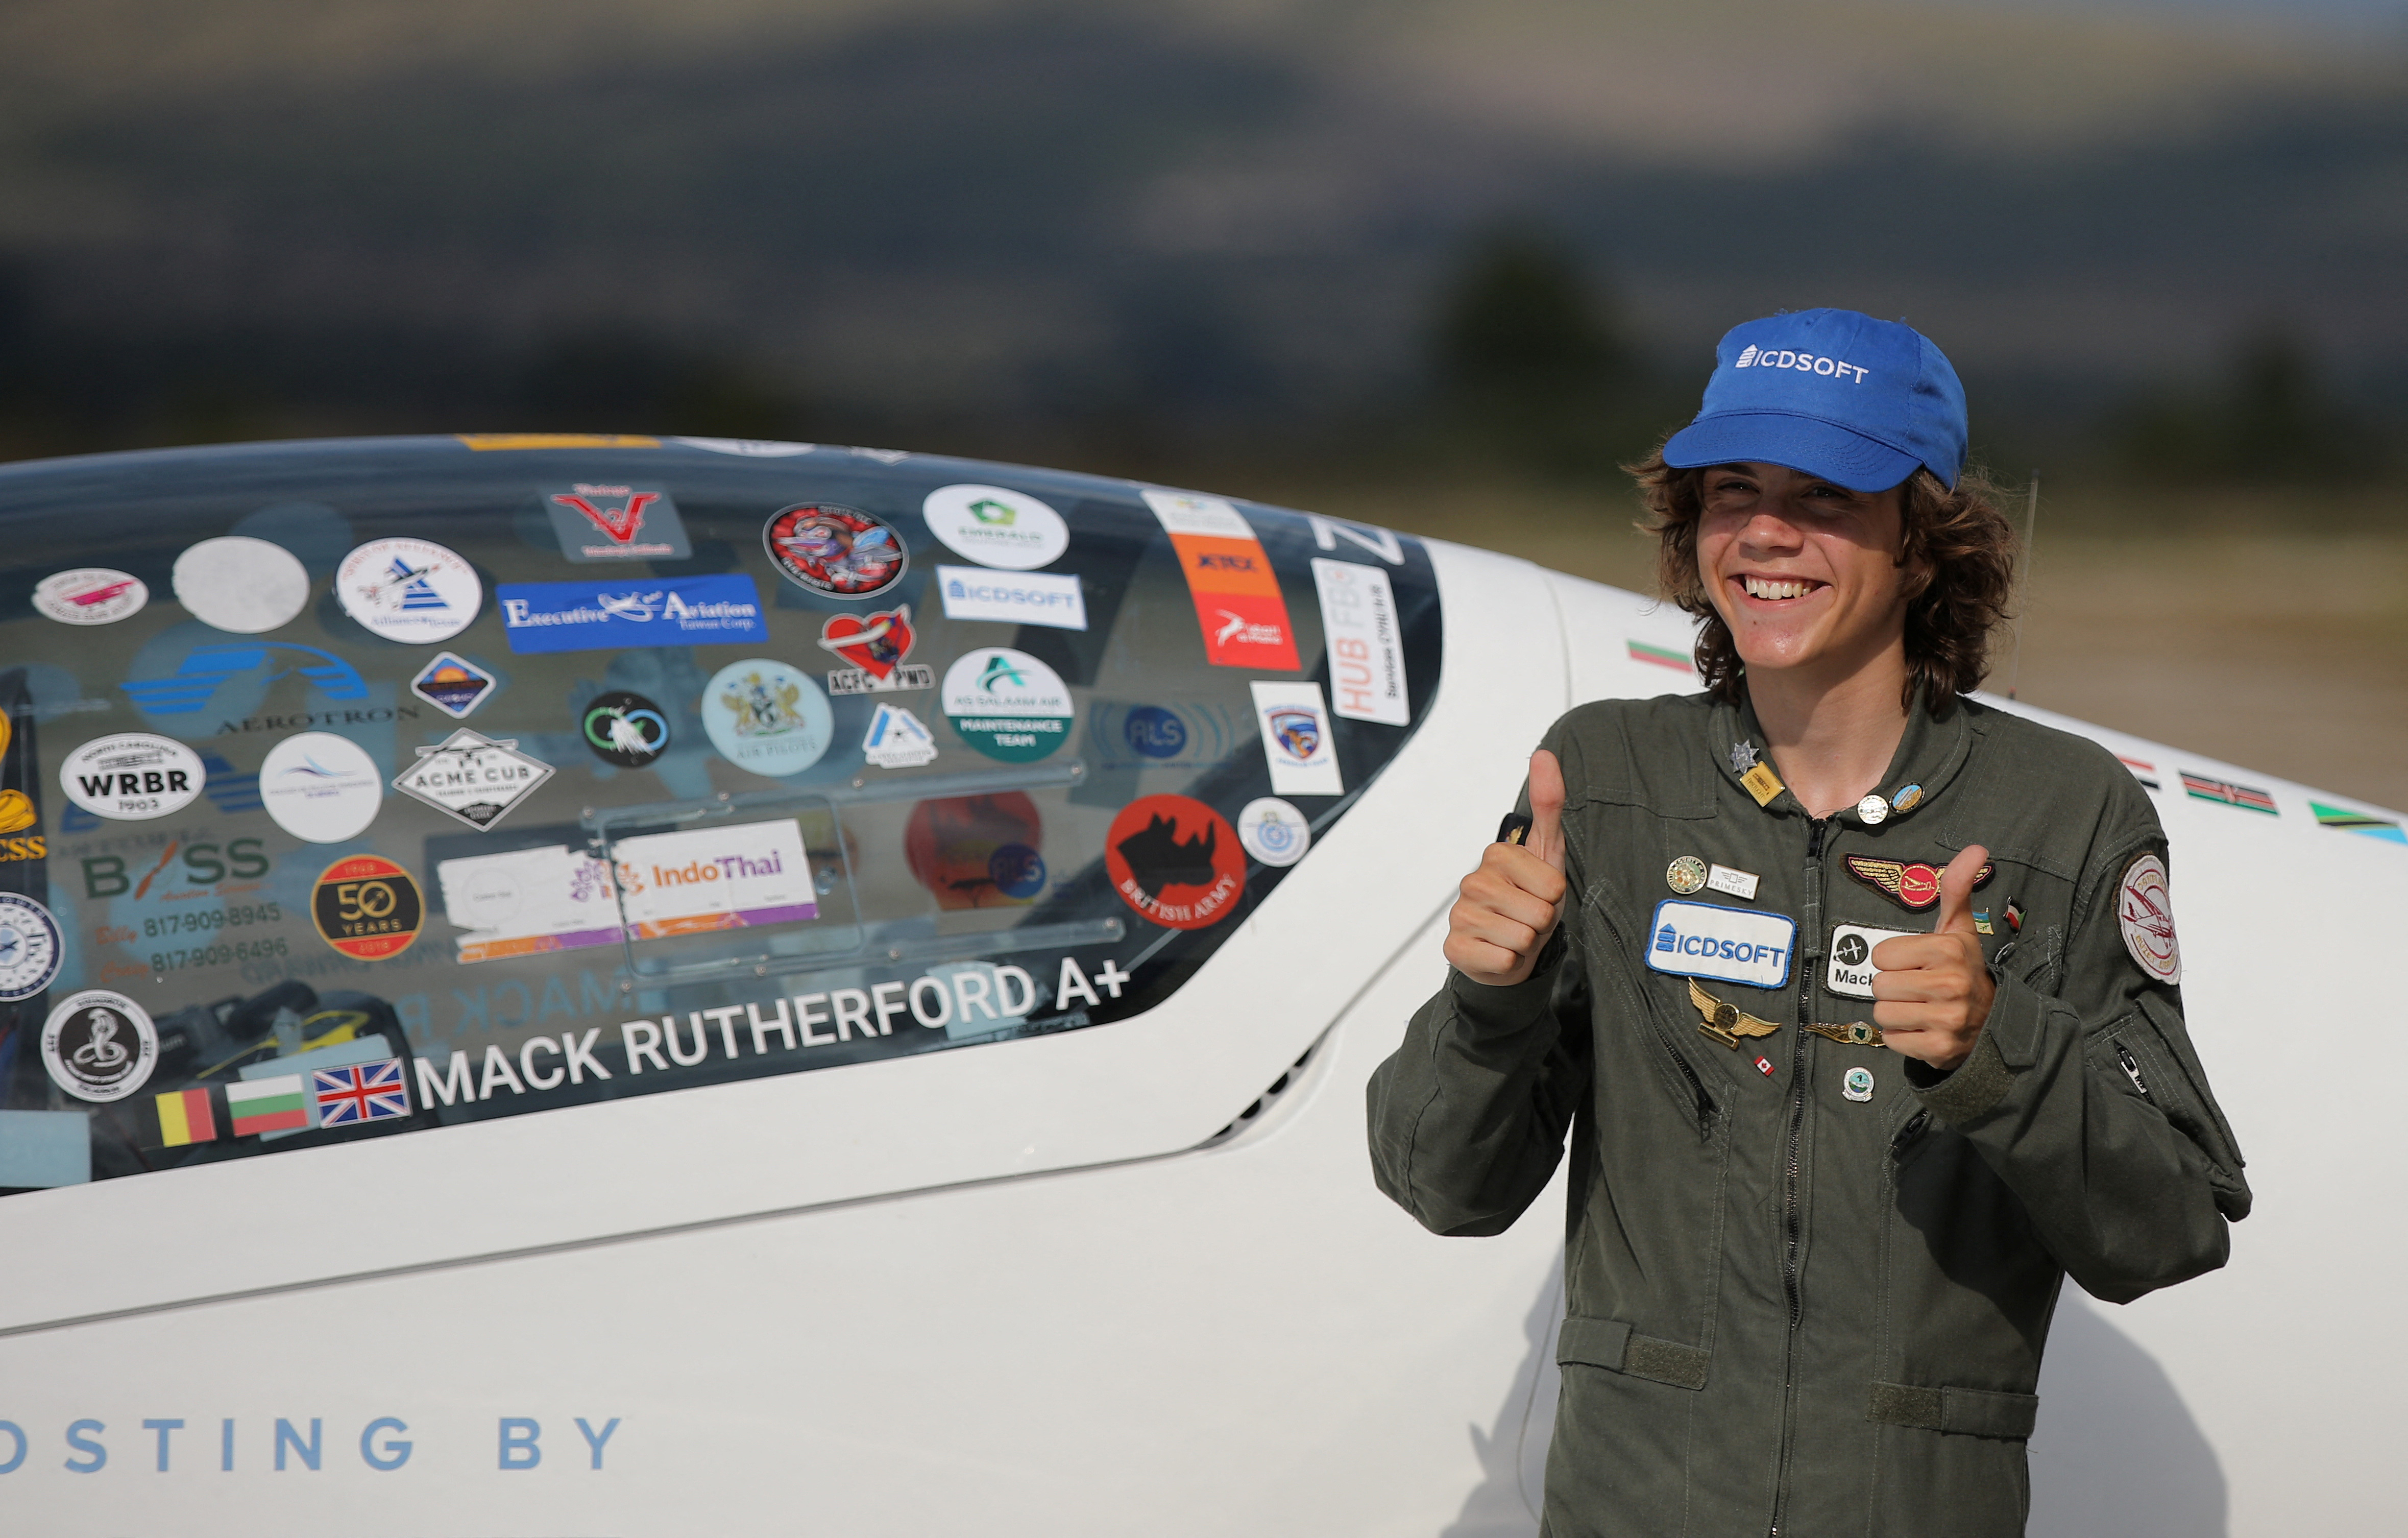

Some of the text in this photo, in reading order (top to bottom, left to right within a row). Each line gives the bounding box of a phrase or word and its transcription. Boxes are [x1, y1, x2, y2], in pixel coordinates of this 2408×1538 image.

[1752, 350, 1870, 384] ICDSOFT
[502, 591, 757, 628] Executive Aviation
[969, 586, 1075, 608] ICDSOFT
[1335, 638, 1373, 713] HUB
[216, 705, 420, 735] AEROTRON
[960, 718, 1063, 733] MAINTENANCE
[993, 733, 1037, 747] TEAM
[78, 771, 190, 797] WRBR
[415, 767, 530, 787] ACME CUB
[651, 850, 782, 887] IndoThai
[337, 880, 397, 921] 50
[1120, 878, 1193, 922] BRITISH
[1194, 873, 1237, 919] ARMY
[1710, 879, 1754, 896] PRIMESKY
[342, 919, 402, 937] YEARS
[1677, 933, 1785, 968] ICDSOFT
[412, 956, 1131, 1111] MACK RUTHERFORD A+
[498, 1416, 622, 1472] BY
